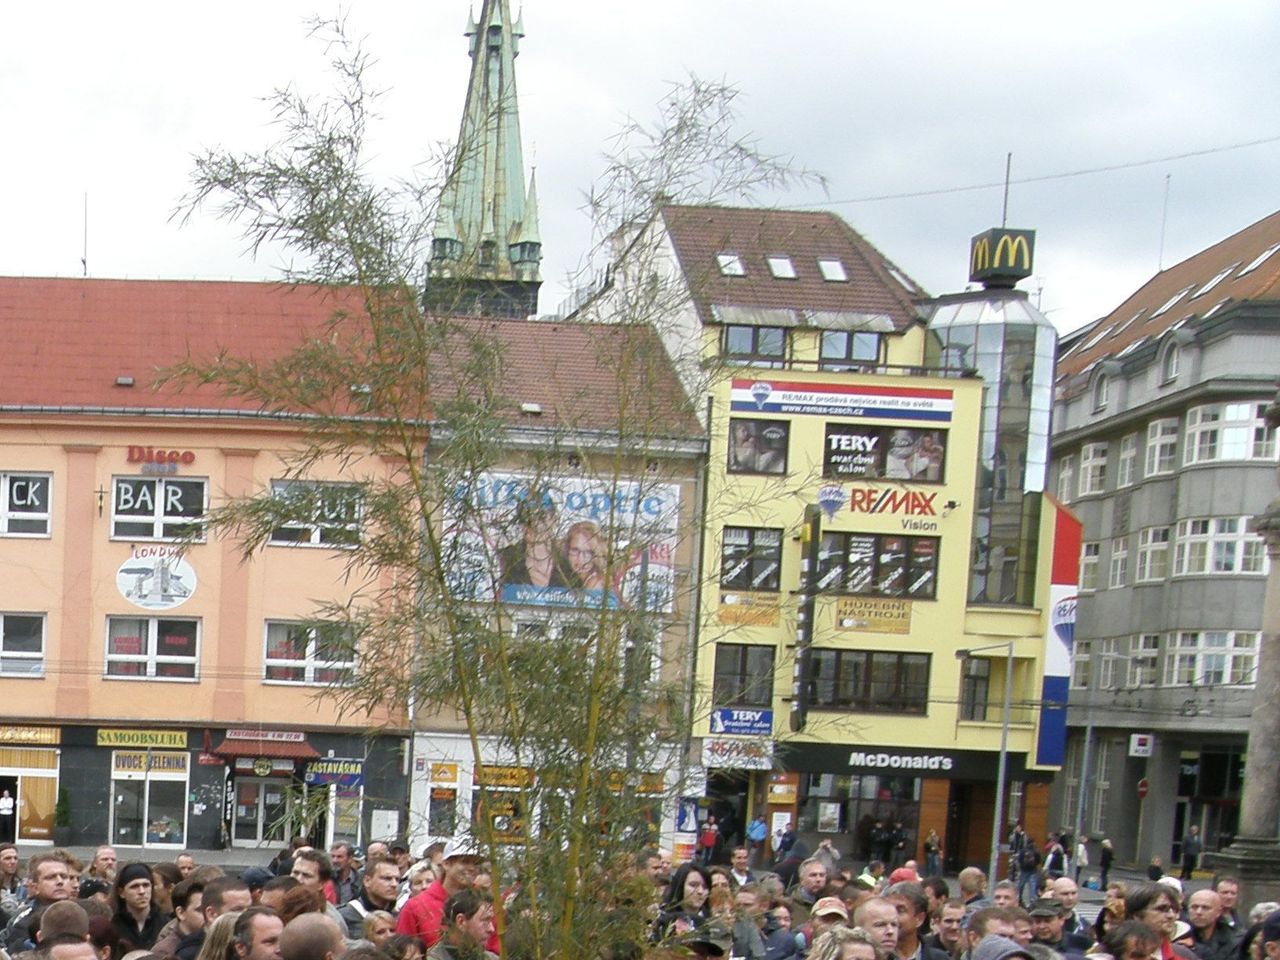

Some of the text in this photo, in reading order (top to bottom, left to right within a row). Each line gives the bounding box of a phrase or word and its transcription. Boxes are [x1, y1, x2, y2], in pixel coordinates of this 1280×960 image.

[828, 434, 879, 451] TERY
[127, 445, 195, 464] Disco
[118, 483, 184, 513] BAR
[850, 488, 938, 516] RE/MAX
[902, 519, 938, 531] Vision
[844, 600, 906, 611] HUDEBNÍ
[838, 608, 907, 619] NÁSTROJE
[731, 710, 763, 721] TERY
[98, 731, 185, 746] SAMOOBSLUHA
[115, 754, 143, 769] OVOCE
[848, 752, 953, 771] McDonald's
